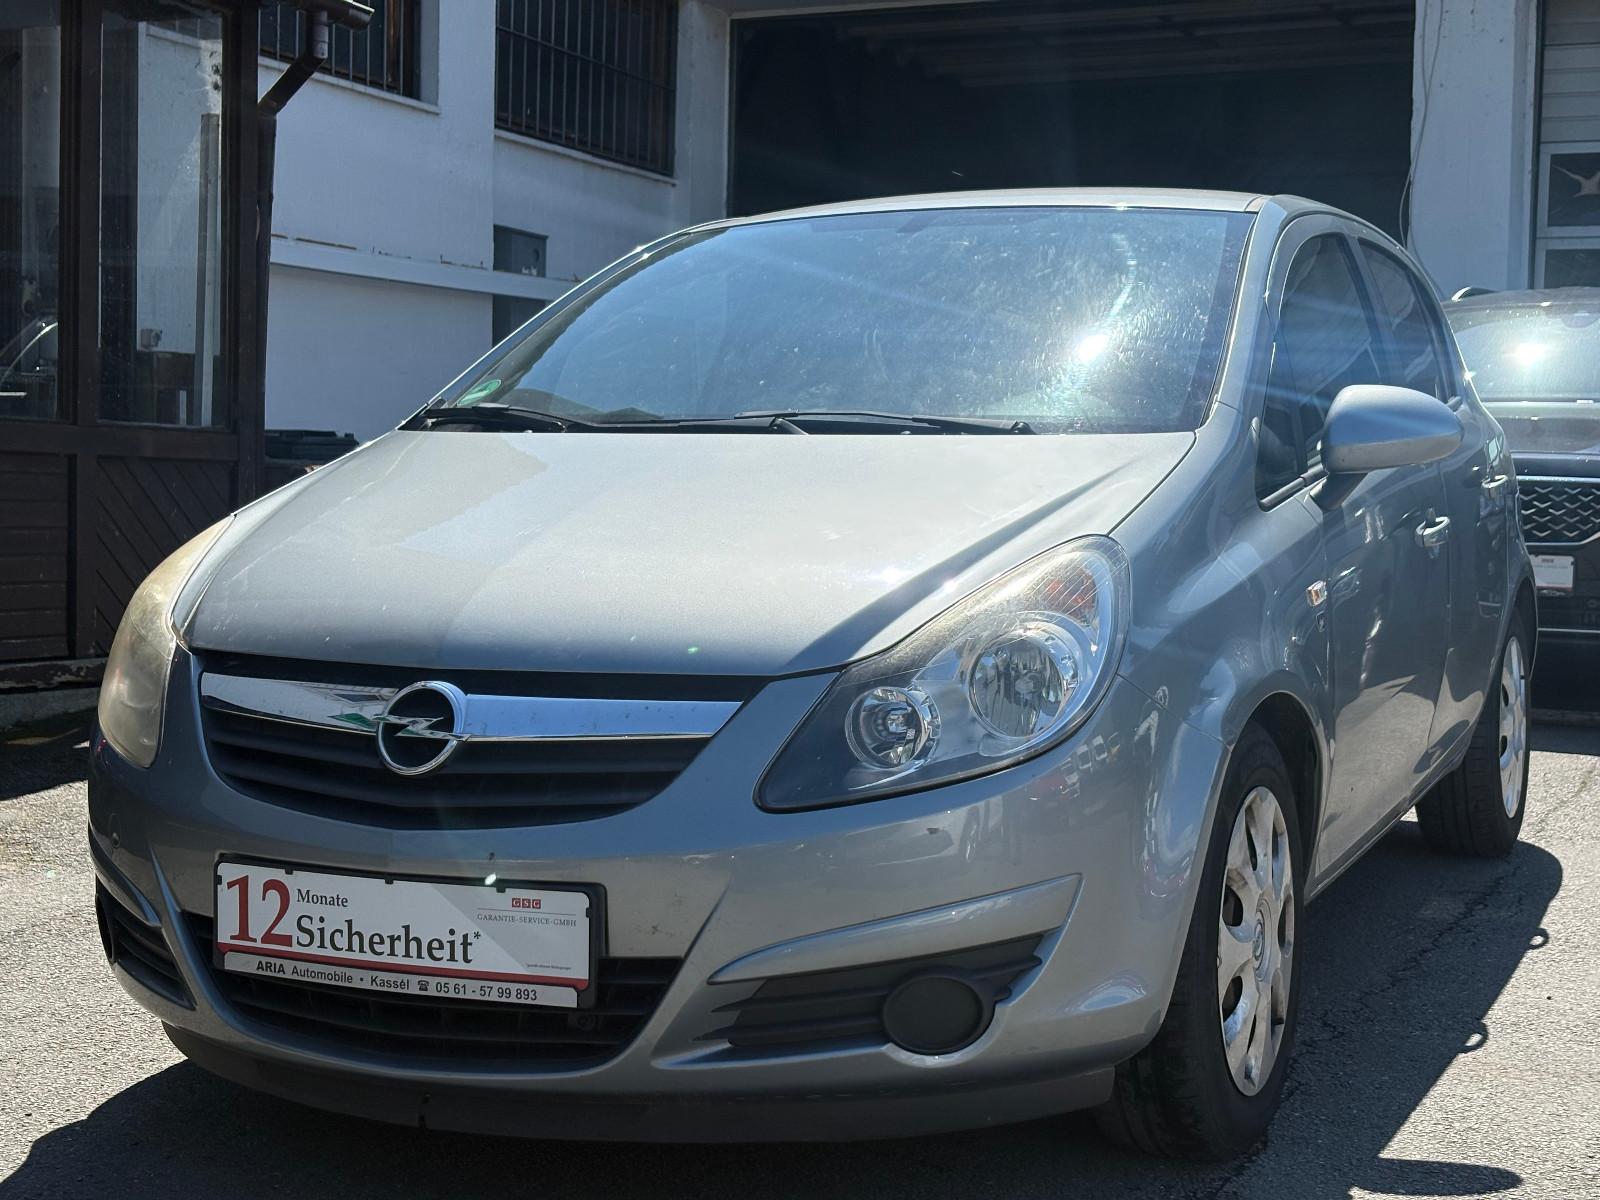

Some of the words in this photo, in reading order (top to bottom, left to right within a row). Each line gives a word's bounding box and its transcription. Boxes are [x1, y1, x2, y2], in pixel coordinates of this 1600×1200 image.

[227, 875, 293, 947] 12
[297, 888, 349, 908] Monate
[511, 897, 541, 910] GSG
[256, 960, 286, 975] ARIA
[291, 965, 353, 984] Automobile
[515, 989, 538, 1001] 893
